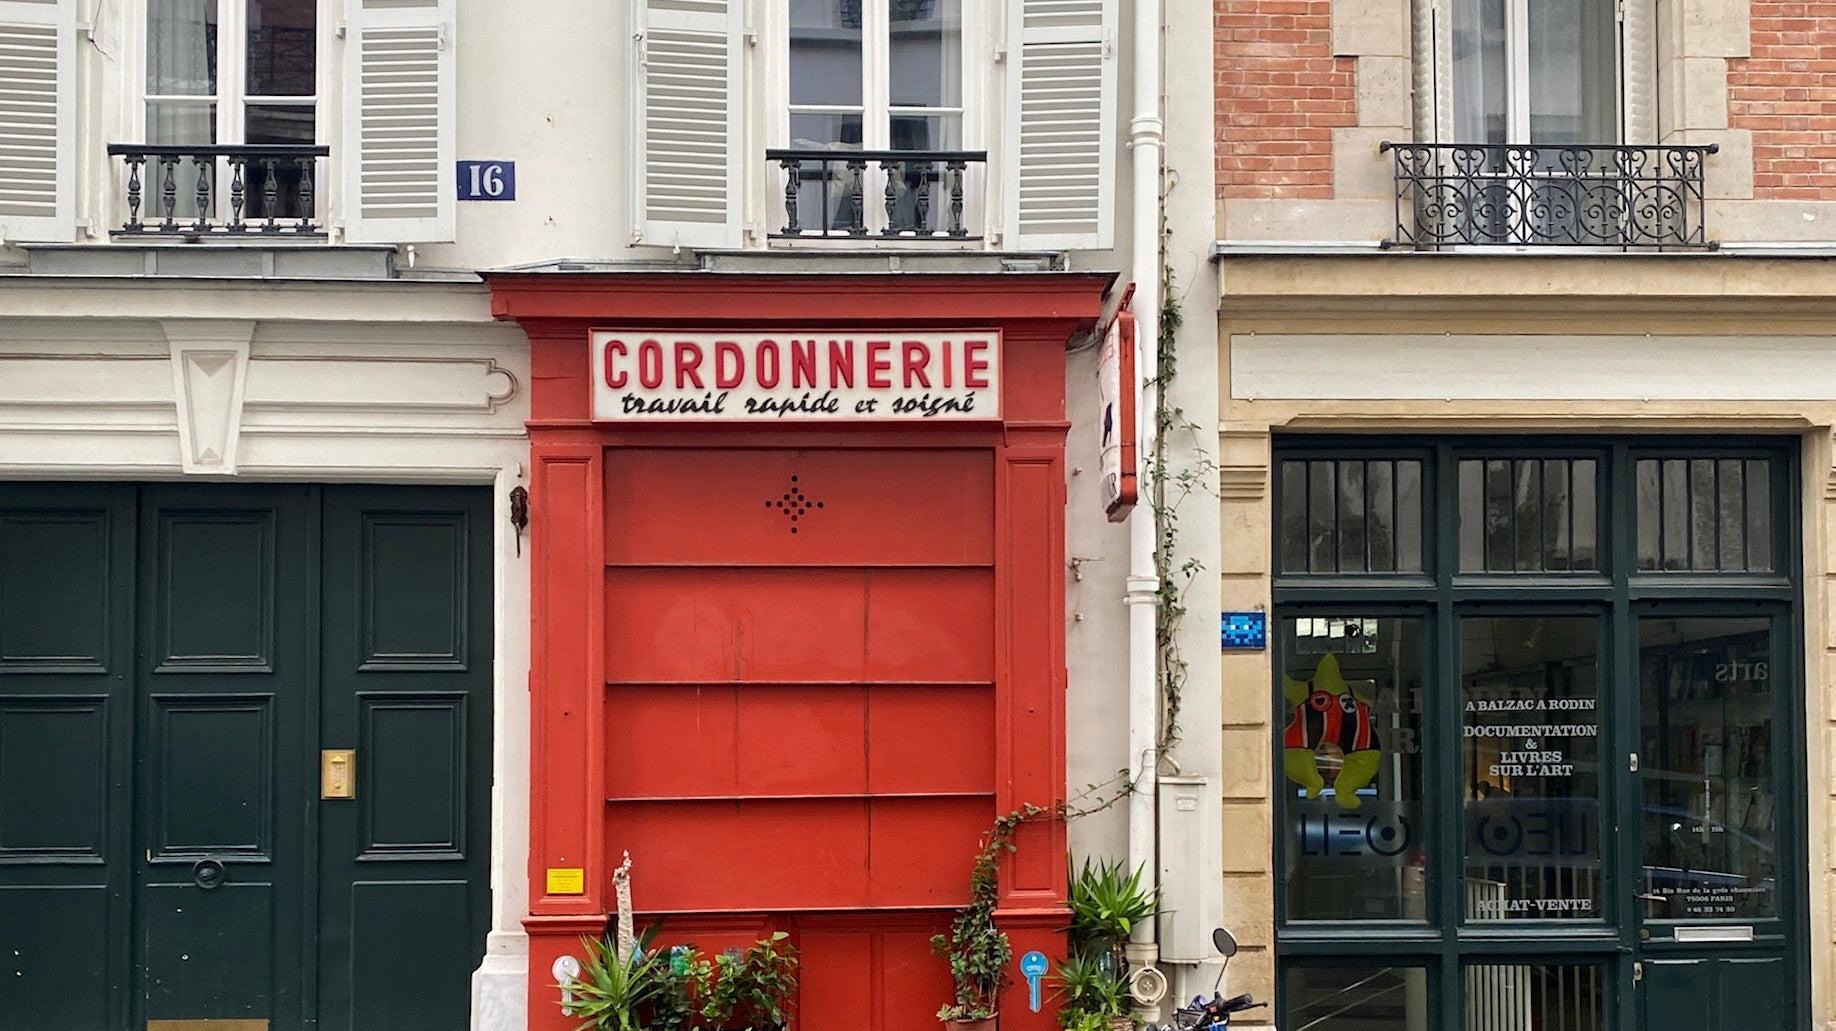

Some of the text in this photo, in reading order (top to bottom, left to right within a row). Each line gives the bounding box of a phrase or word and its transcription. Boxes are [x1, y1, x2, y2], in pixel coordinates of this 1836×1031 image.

[469, 165, 504, 197] 16
[603, 339, 989, 390] CORDONNERIE
[621, 390, 975, 417] travail rapide et soigné
[1465, 699, 1596, 711] A BALZAC A RODIN
[1463, 725, 1598, 737] DOCUMENTATION
[1525, 738, 1538, 750] &
[1500, 751, 1562, 763] LIVRES
[1489, 764, 1574, 776] SUR L'ART
[1475, 898, 1593, 911] ACHAT-VENTE
